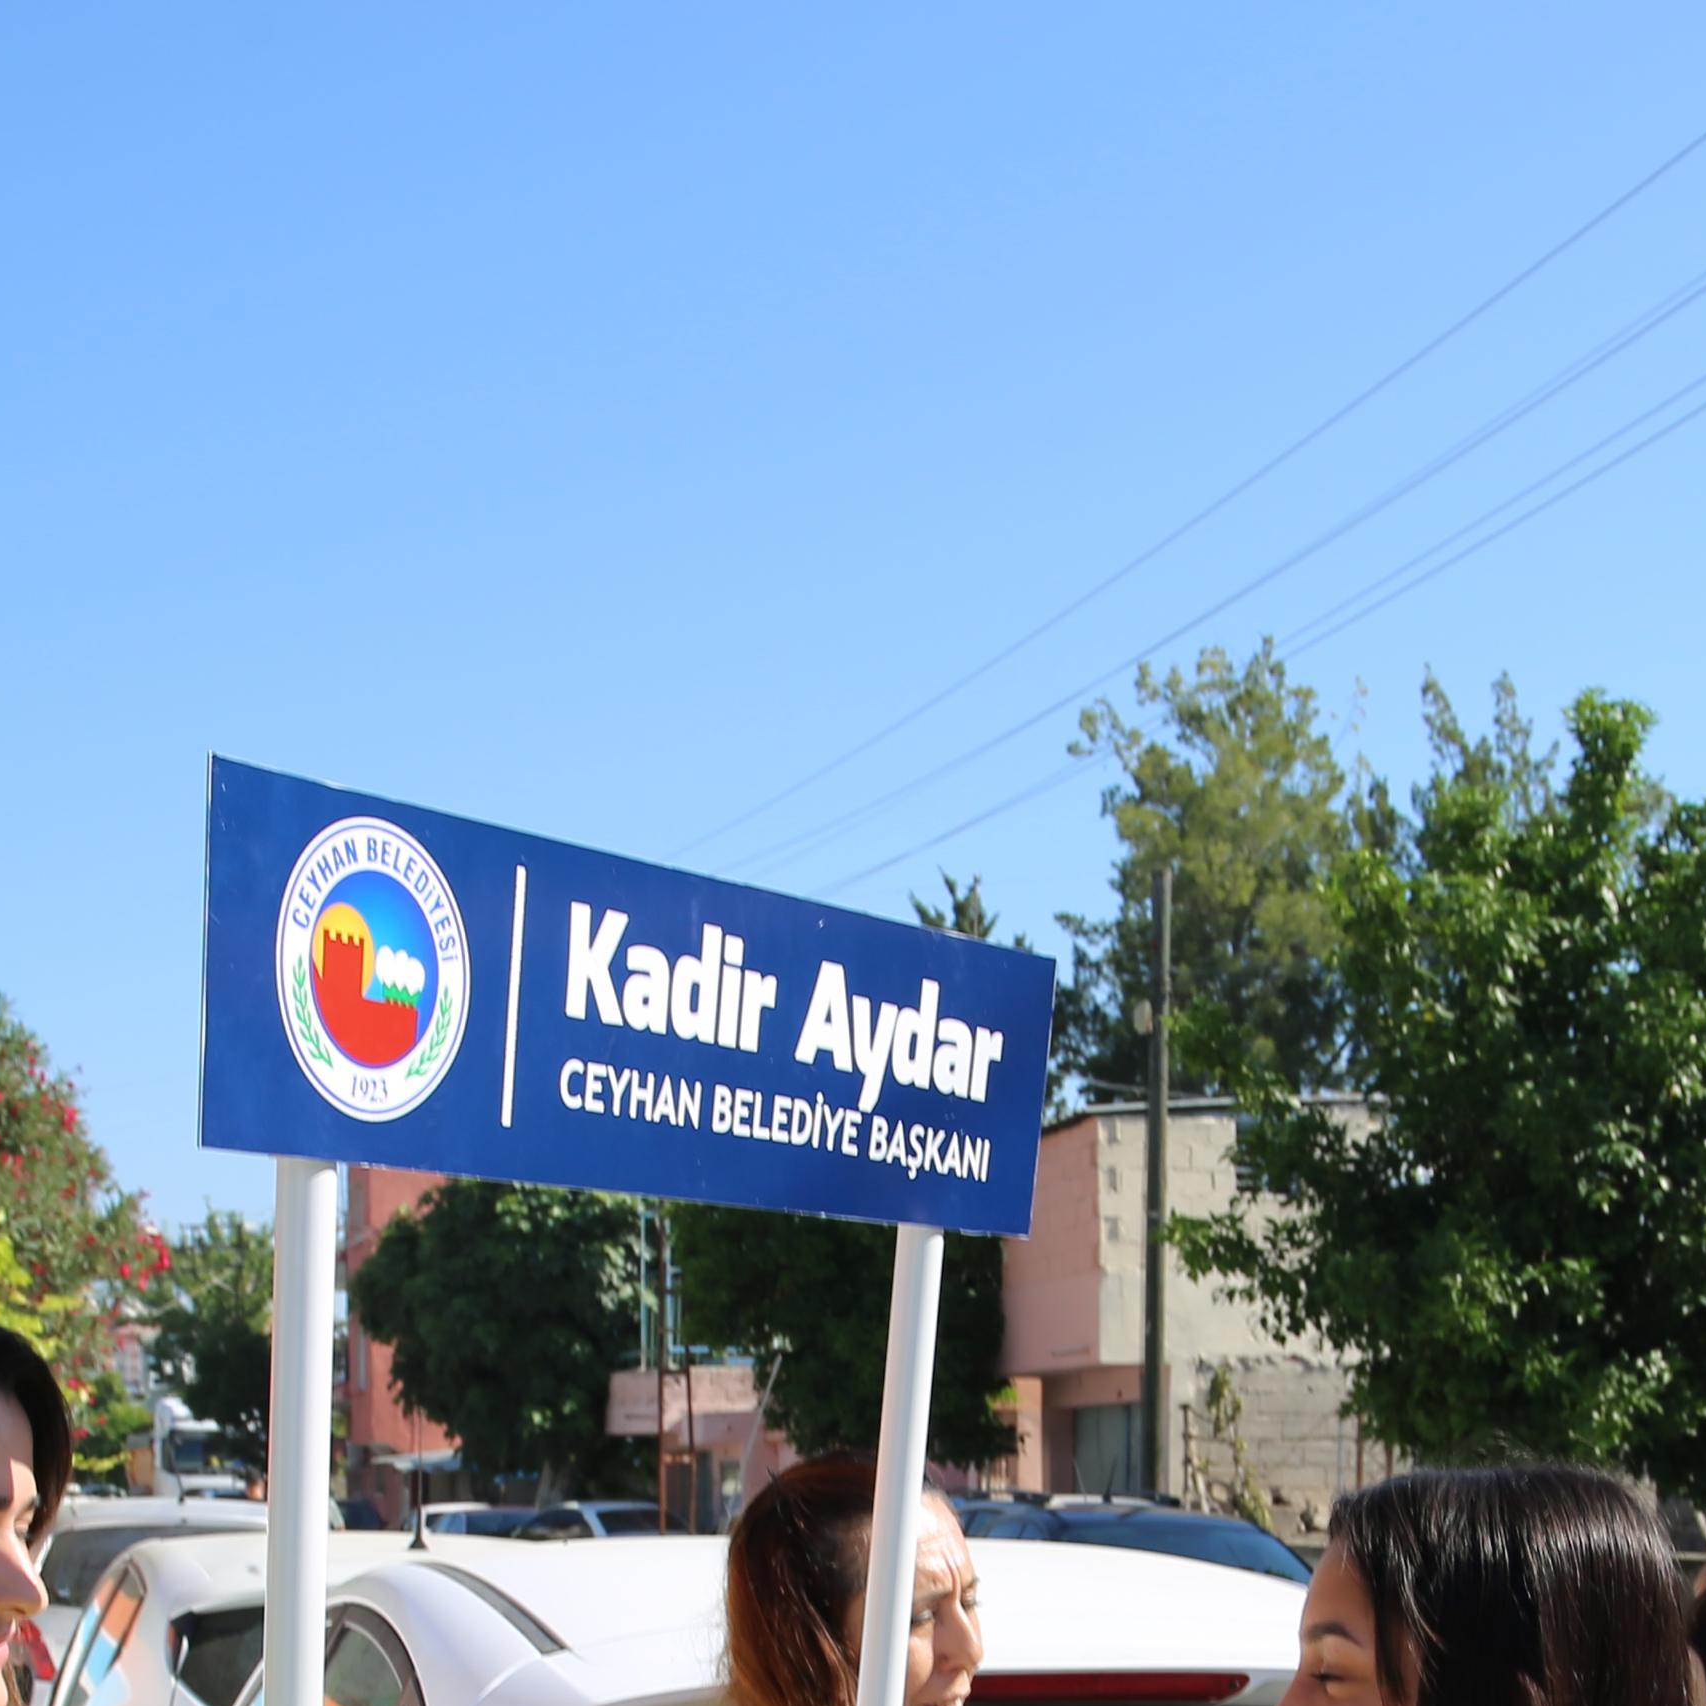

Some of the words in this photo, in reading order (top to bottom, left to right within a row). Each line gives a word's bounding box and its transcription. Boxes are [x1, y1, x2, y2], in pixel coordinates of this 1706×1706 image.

[292, 837, 359, 931] CEYHAN
[564, 900, 778, 1053] Kadir
[793, 959, 1004, 1114] Aydar
[351, 1075, 389, 1104] 1923
[558, 1057, 702, 1130] CEYHAN
[710, 1083, 863, 1157] BELEDİYE
[867, 1114, 991, 1182] BAŞKANI
